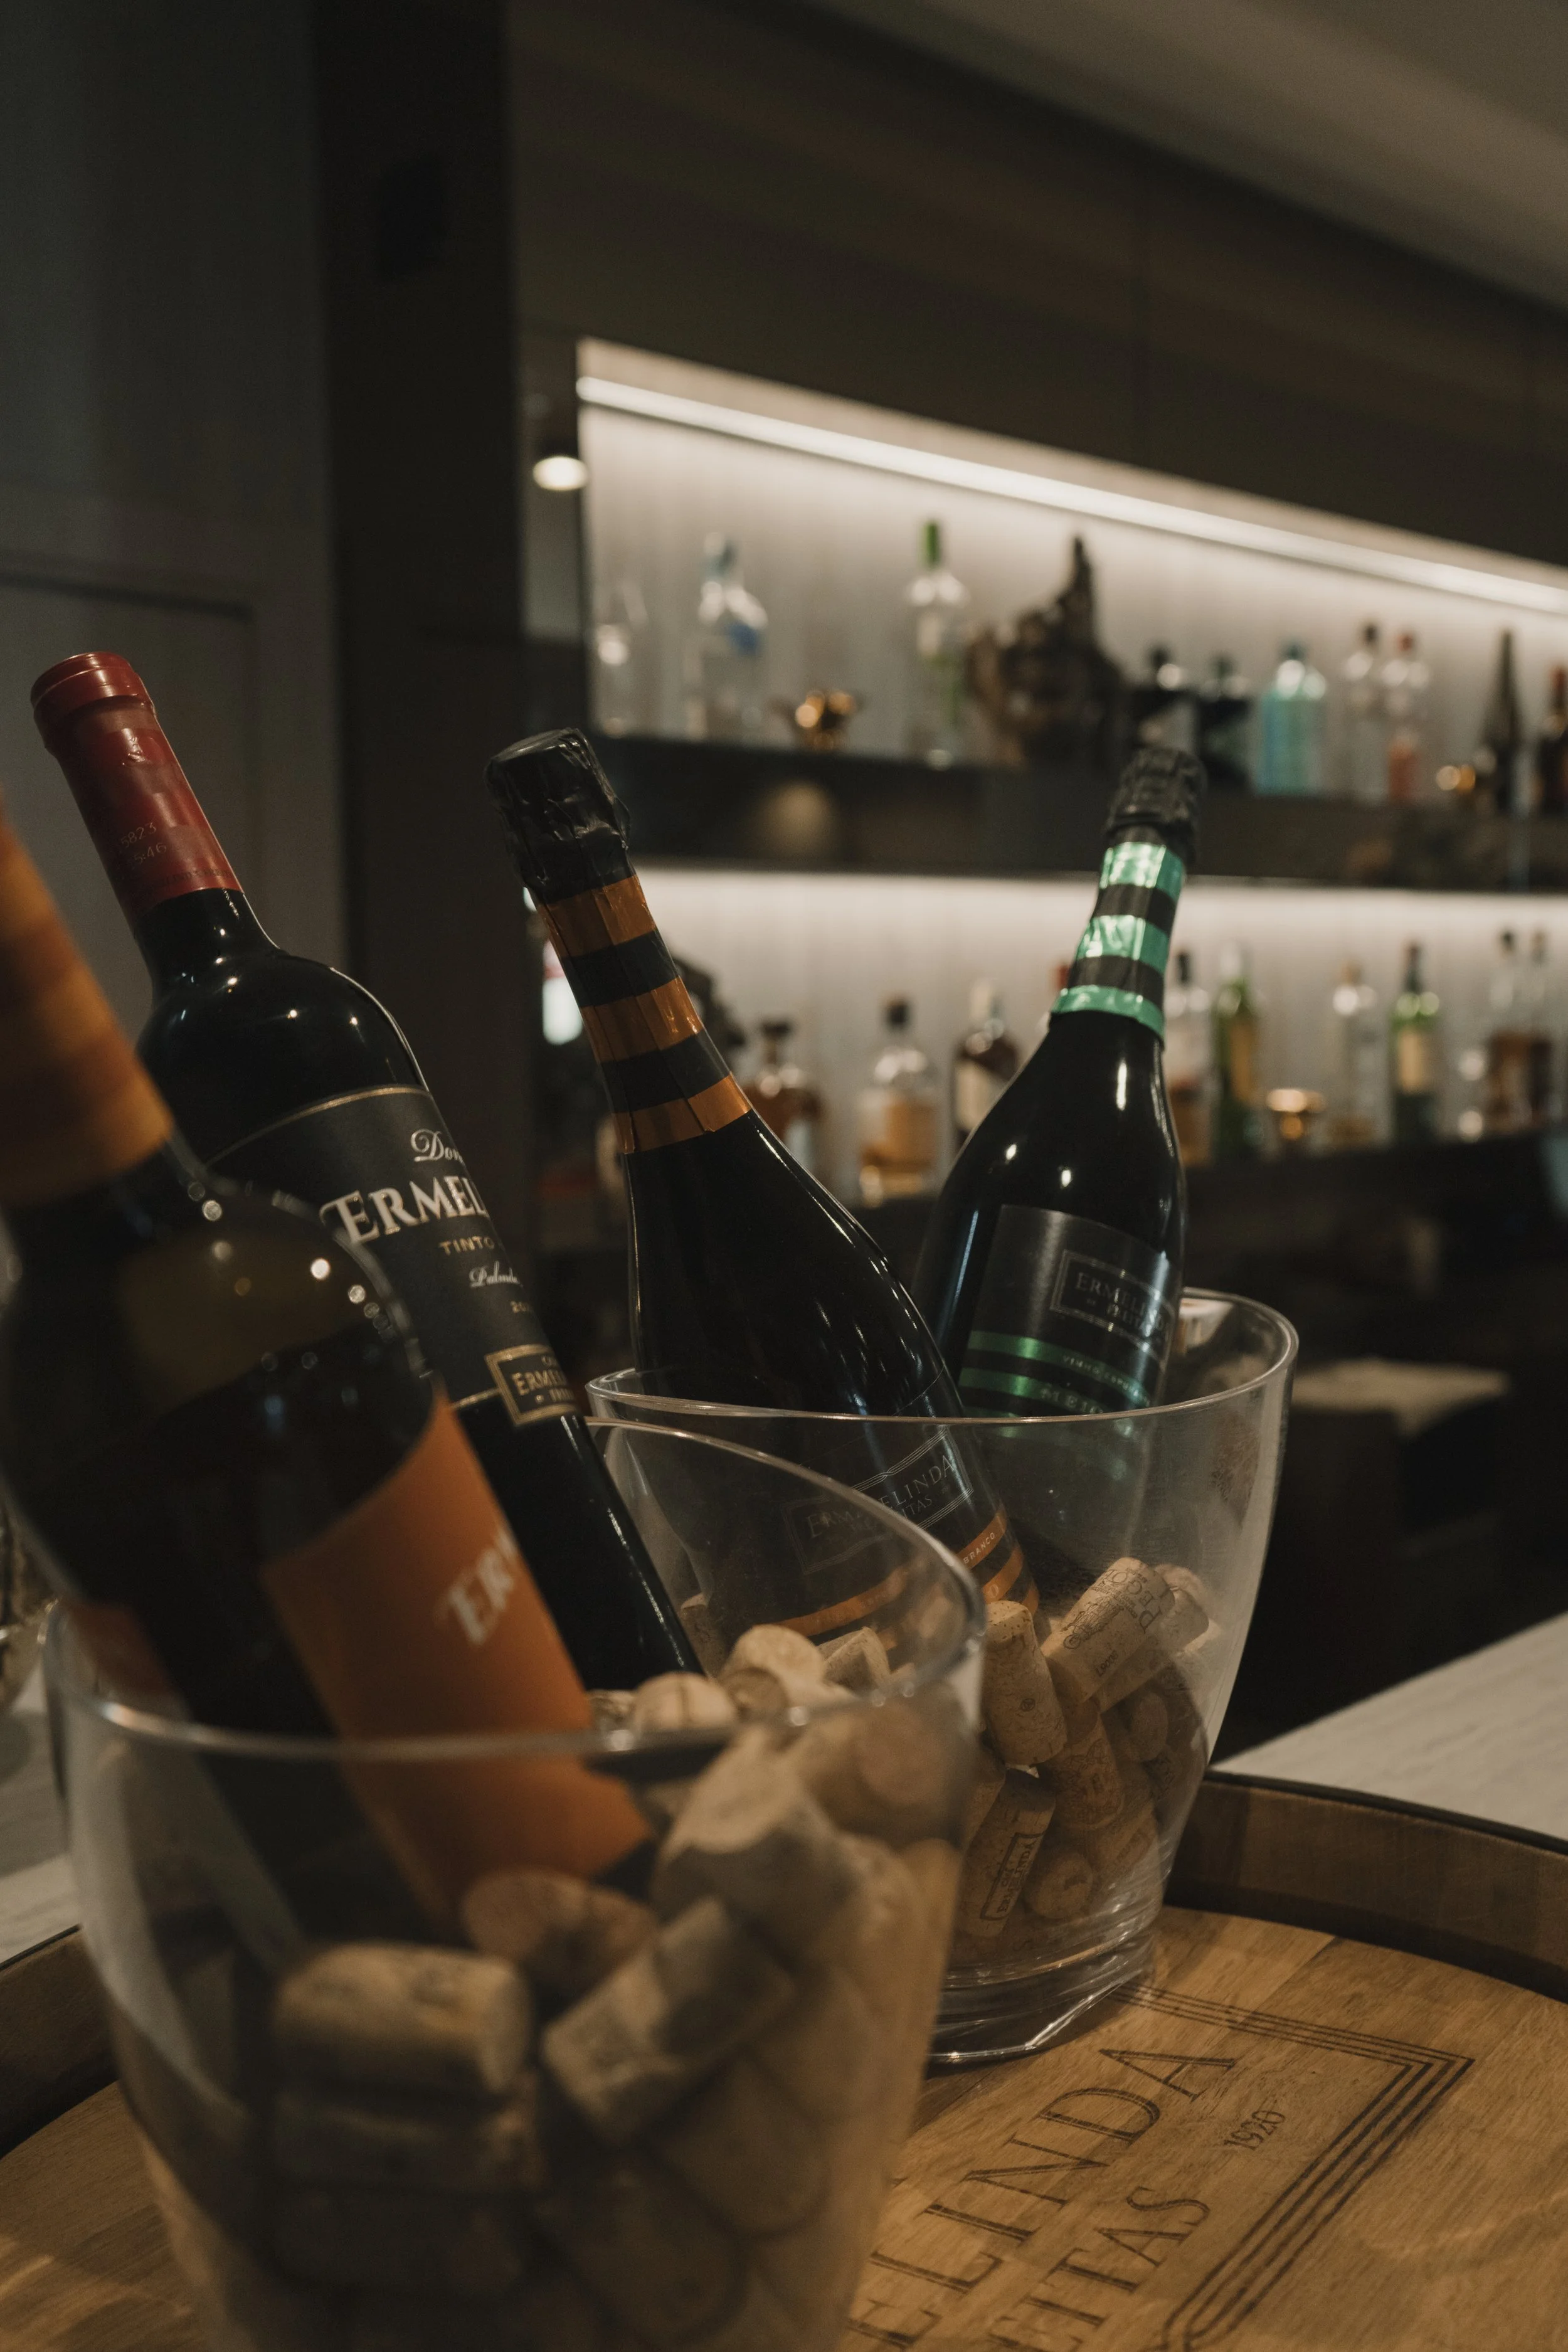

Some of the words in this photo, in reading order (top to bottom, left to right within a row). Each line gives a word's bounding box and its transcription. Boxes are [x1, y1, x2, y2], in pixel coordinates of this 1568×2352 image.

[438, 1236, 495, 1256] TINTO
[963, 1532, 996, 1564] BRANCO
[1223, 2107, 1286, 2152] 1920
